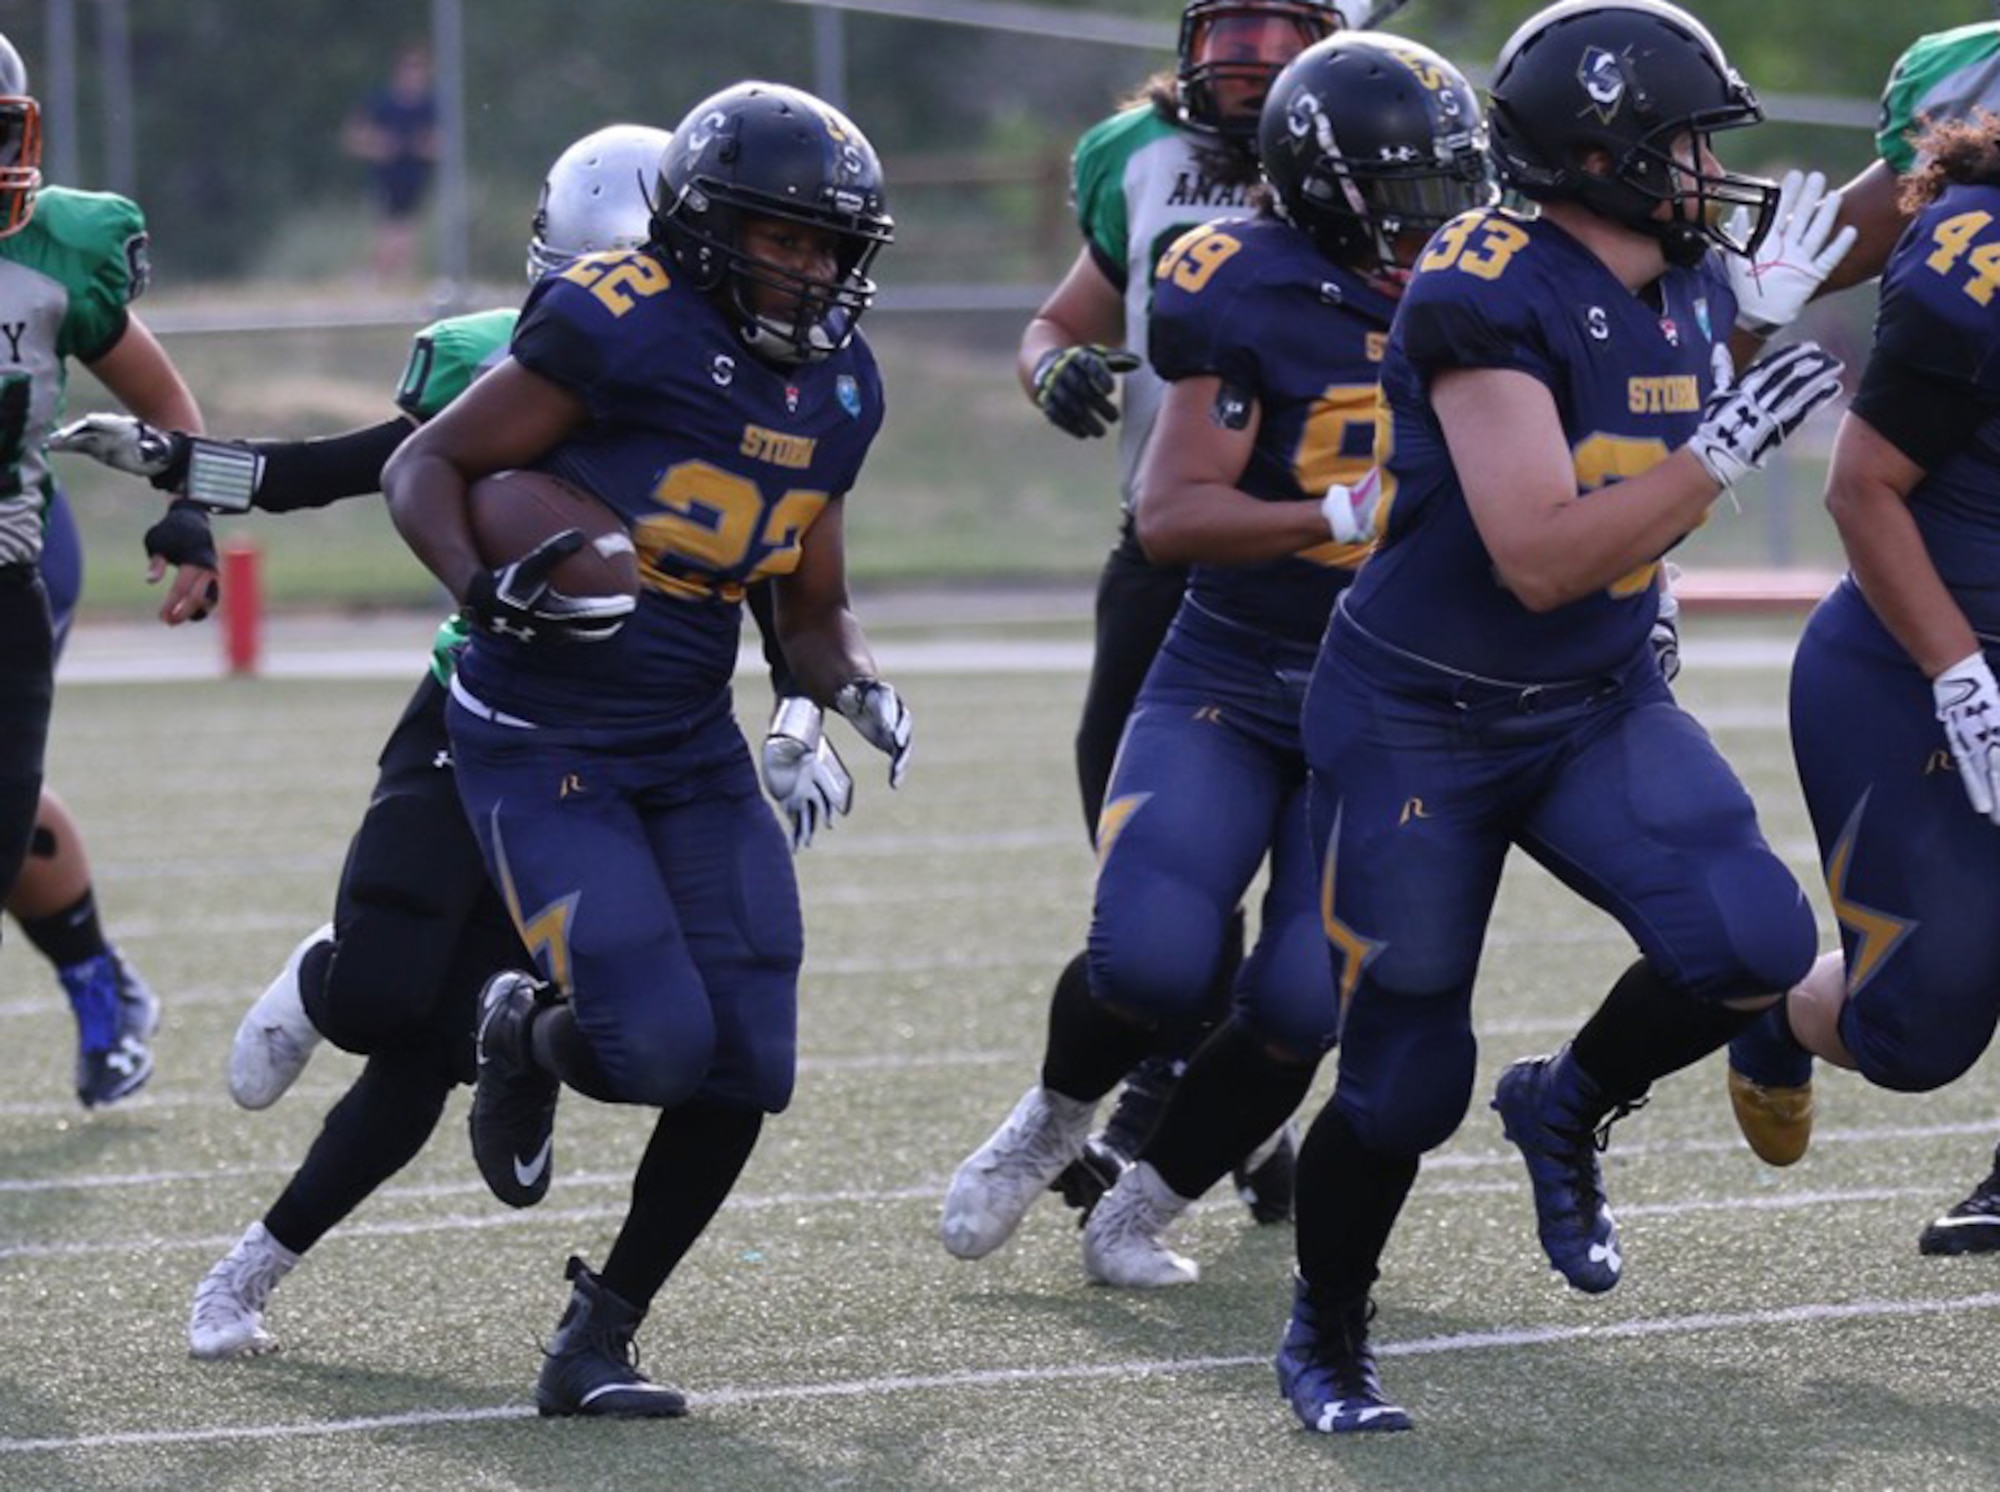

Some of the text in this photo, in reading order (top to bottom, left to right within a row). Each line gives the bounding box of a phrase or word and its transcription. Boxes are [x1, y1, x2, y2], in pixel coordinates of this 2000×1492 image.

[1420, 210, 1530, 280] 33
[562, 250, 671, 318] 22
[635, 458, 830, 602] 22
